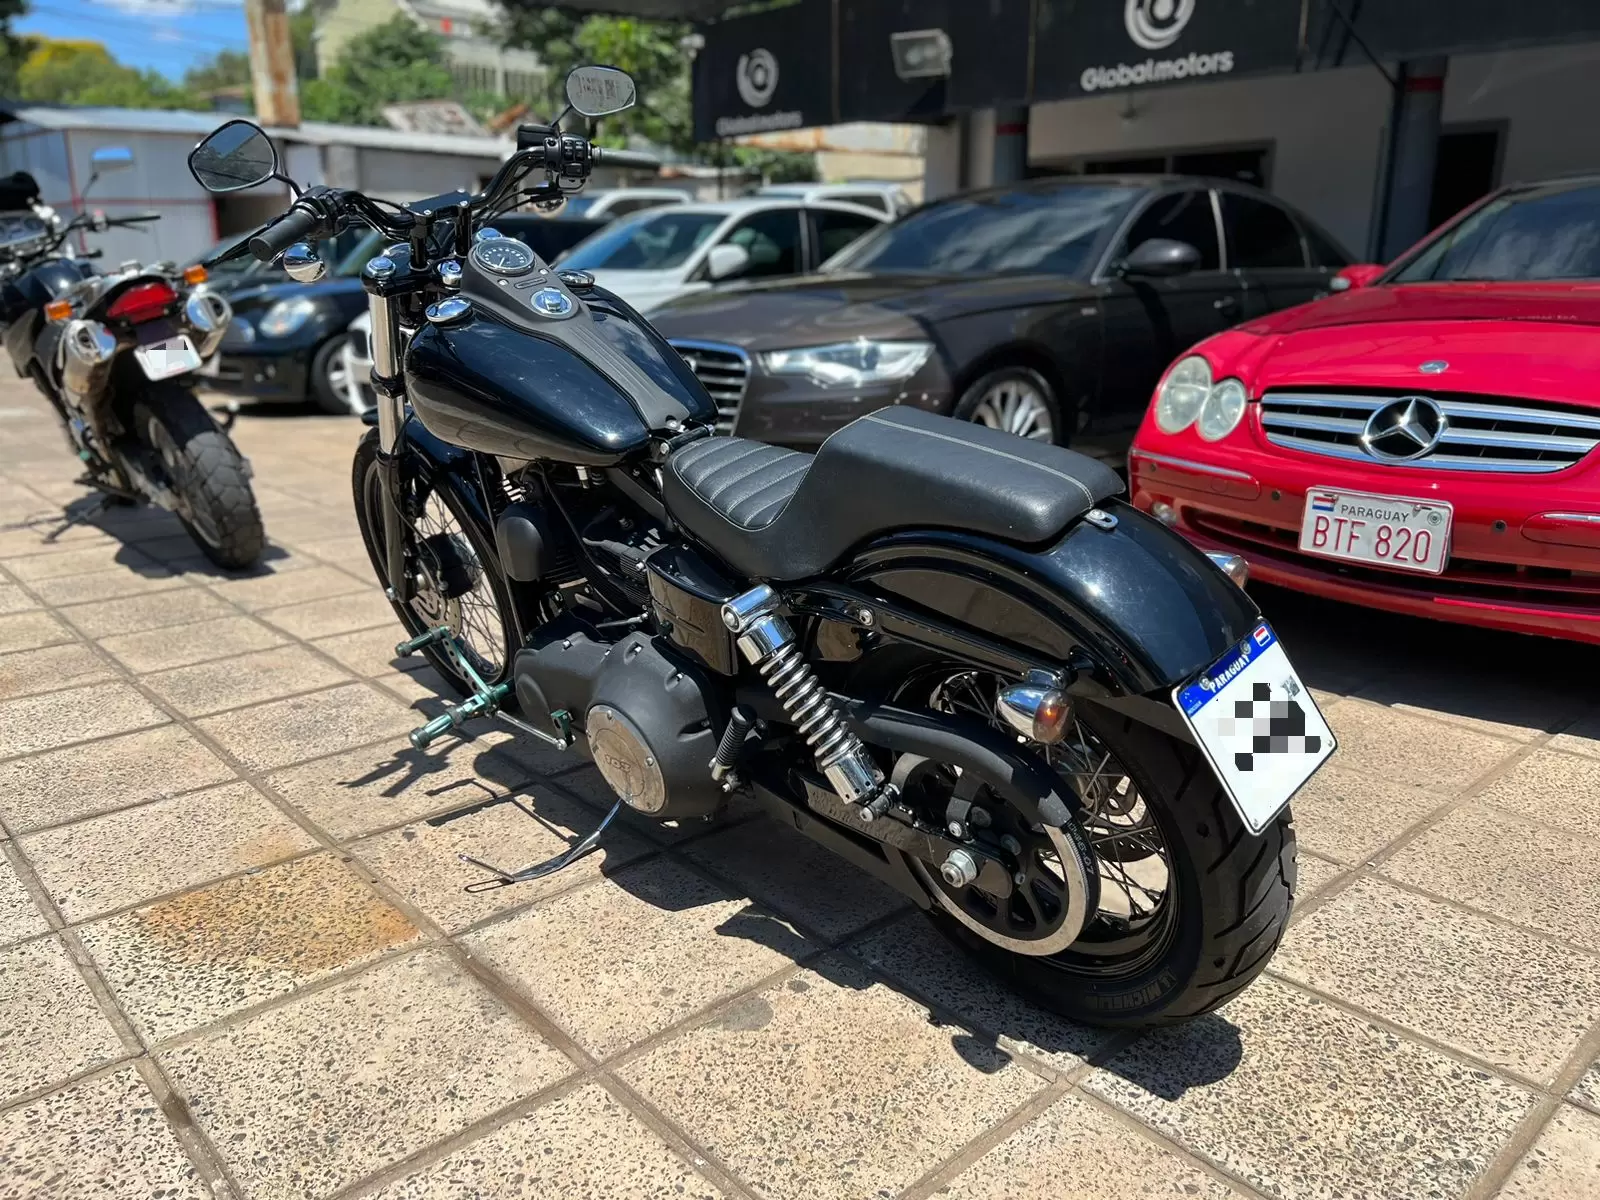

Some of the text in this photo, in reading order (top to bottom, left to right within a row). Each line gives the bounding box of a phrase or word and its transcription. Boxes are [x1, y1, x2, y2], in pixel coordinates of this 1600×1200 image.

[1340, 504, 1409, 523] PARAGUAY
[1312, 515, 1432, 564] BTF 820
[1208, 654, 1250, 693] PARAGUAY
